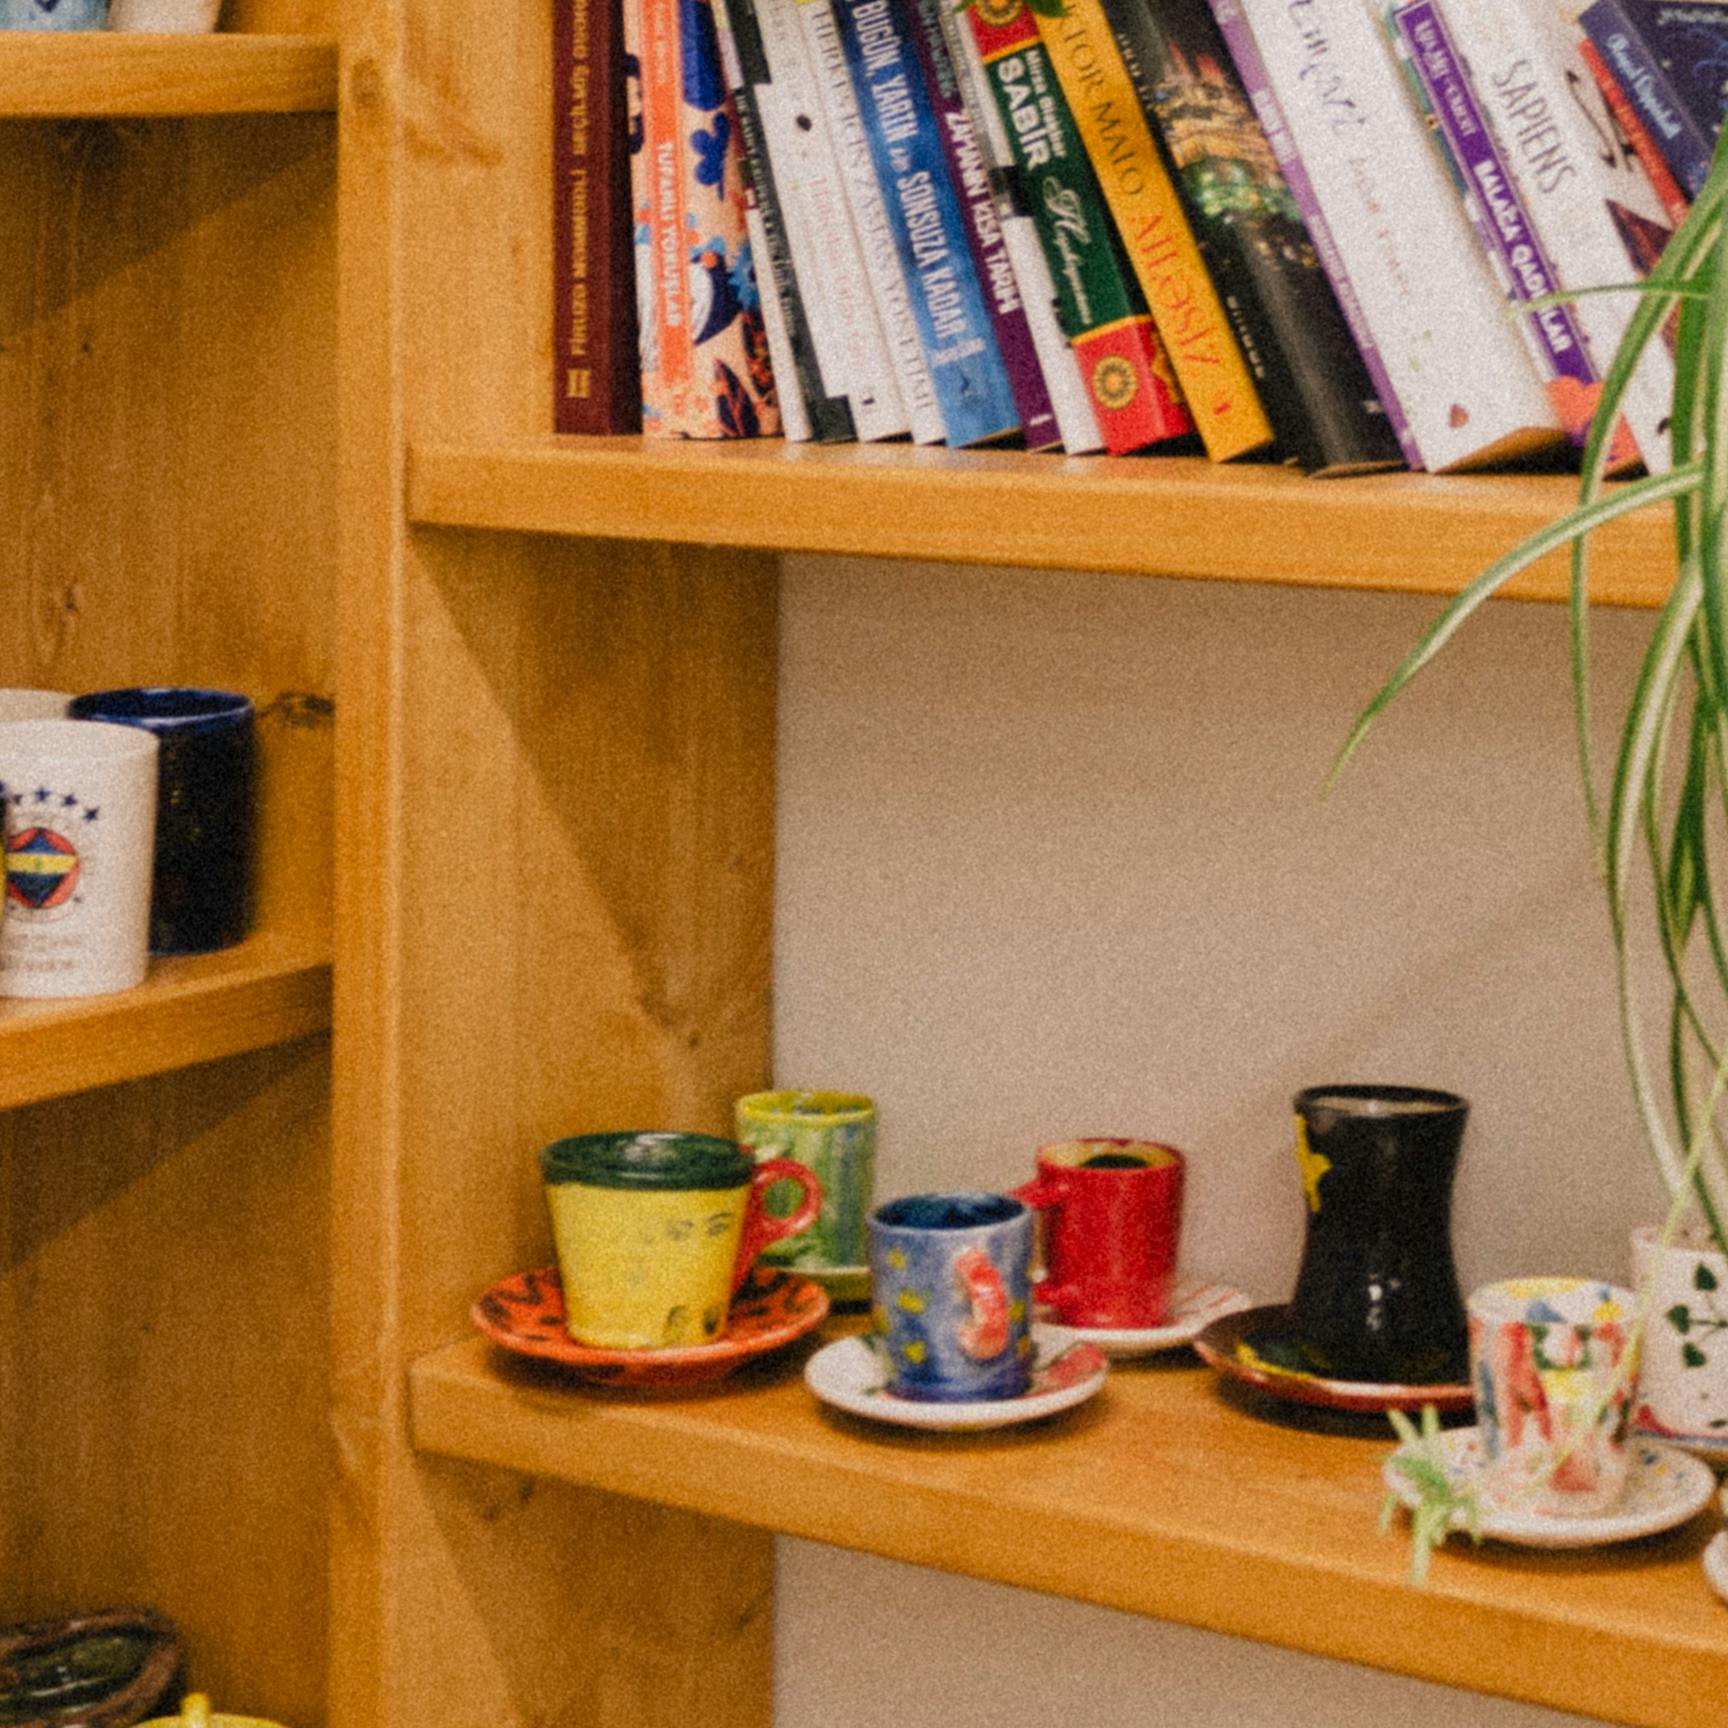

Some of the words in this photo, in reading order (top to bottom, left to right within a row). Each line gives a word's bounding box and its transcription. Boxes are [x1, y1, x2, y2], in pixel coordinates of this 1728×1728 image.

[870, 71, 919, 144] YARIN
[1091, 97, 1146, 198] MALO
[1490, 57, 1577, 197] SAPIENS
[895, 169, 951, 268] SONSUZA
[943, 103, 989, 201] ZAMANIN
[968, 195, 1003, 250] KISA
[1470, 156, 1526, 242] BALACA
[919, 265, 968, 340] KADAR
